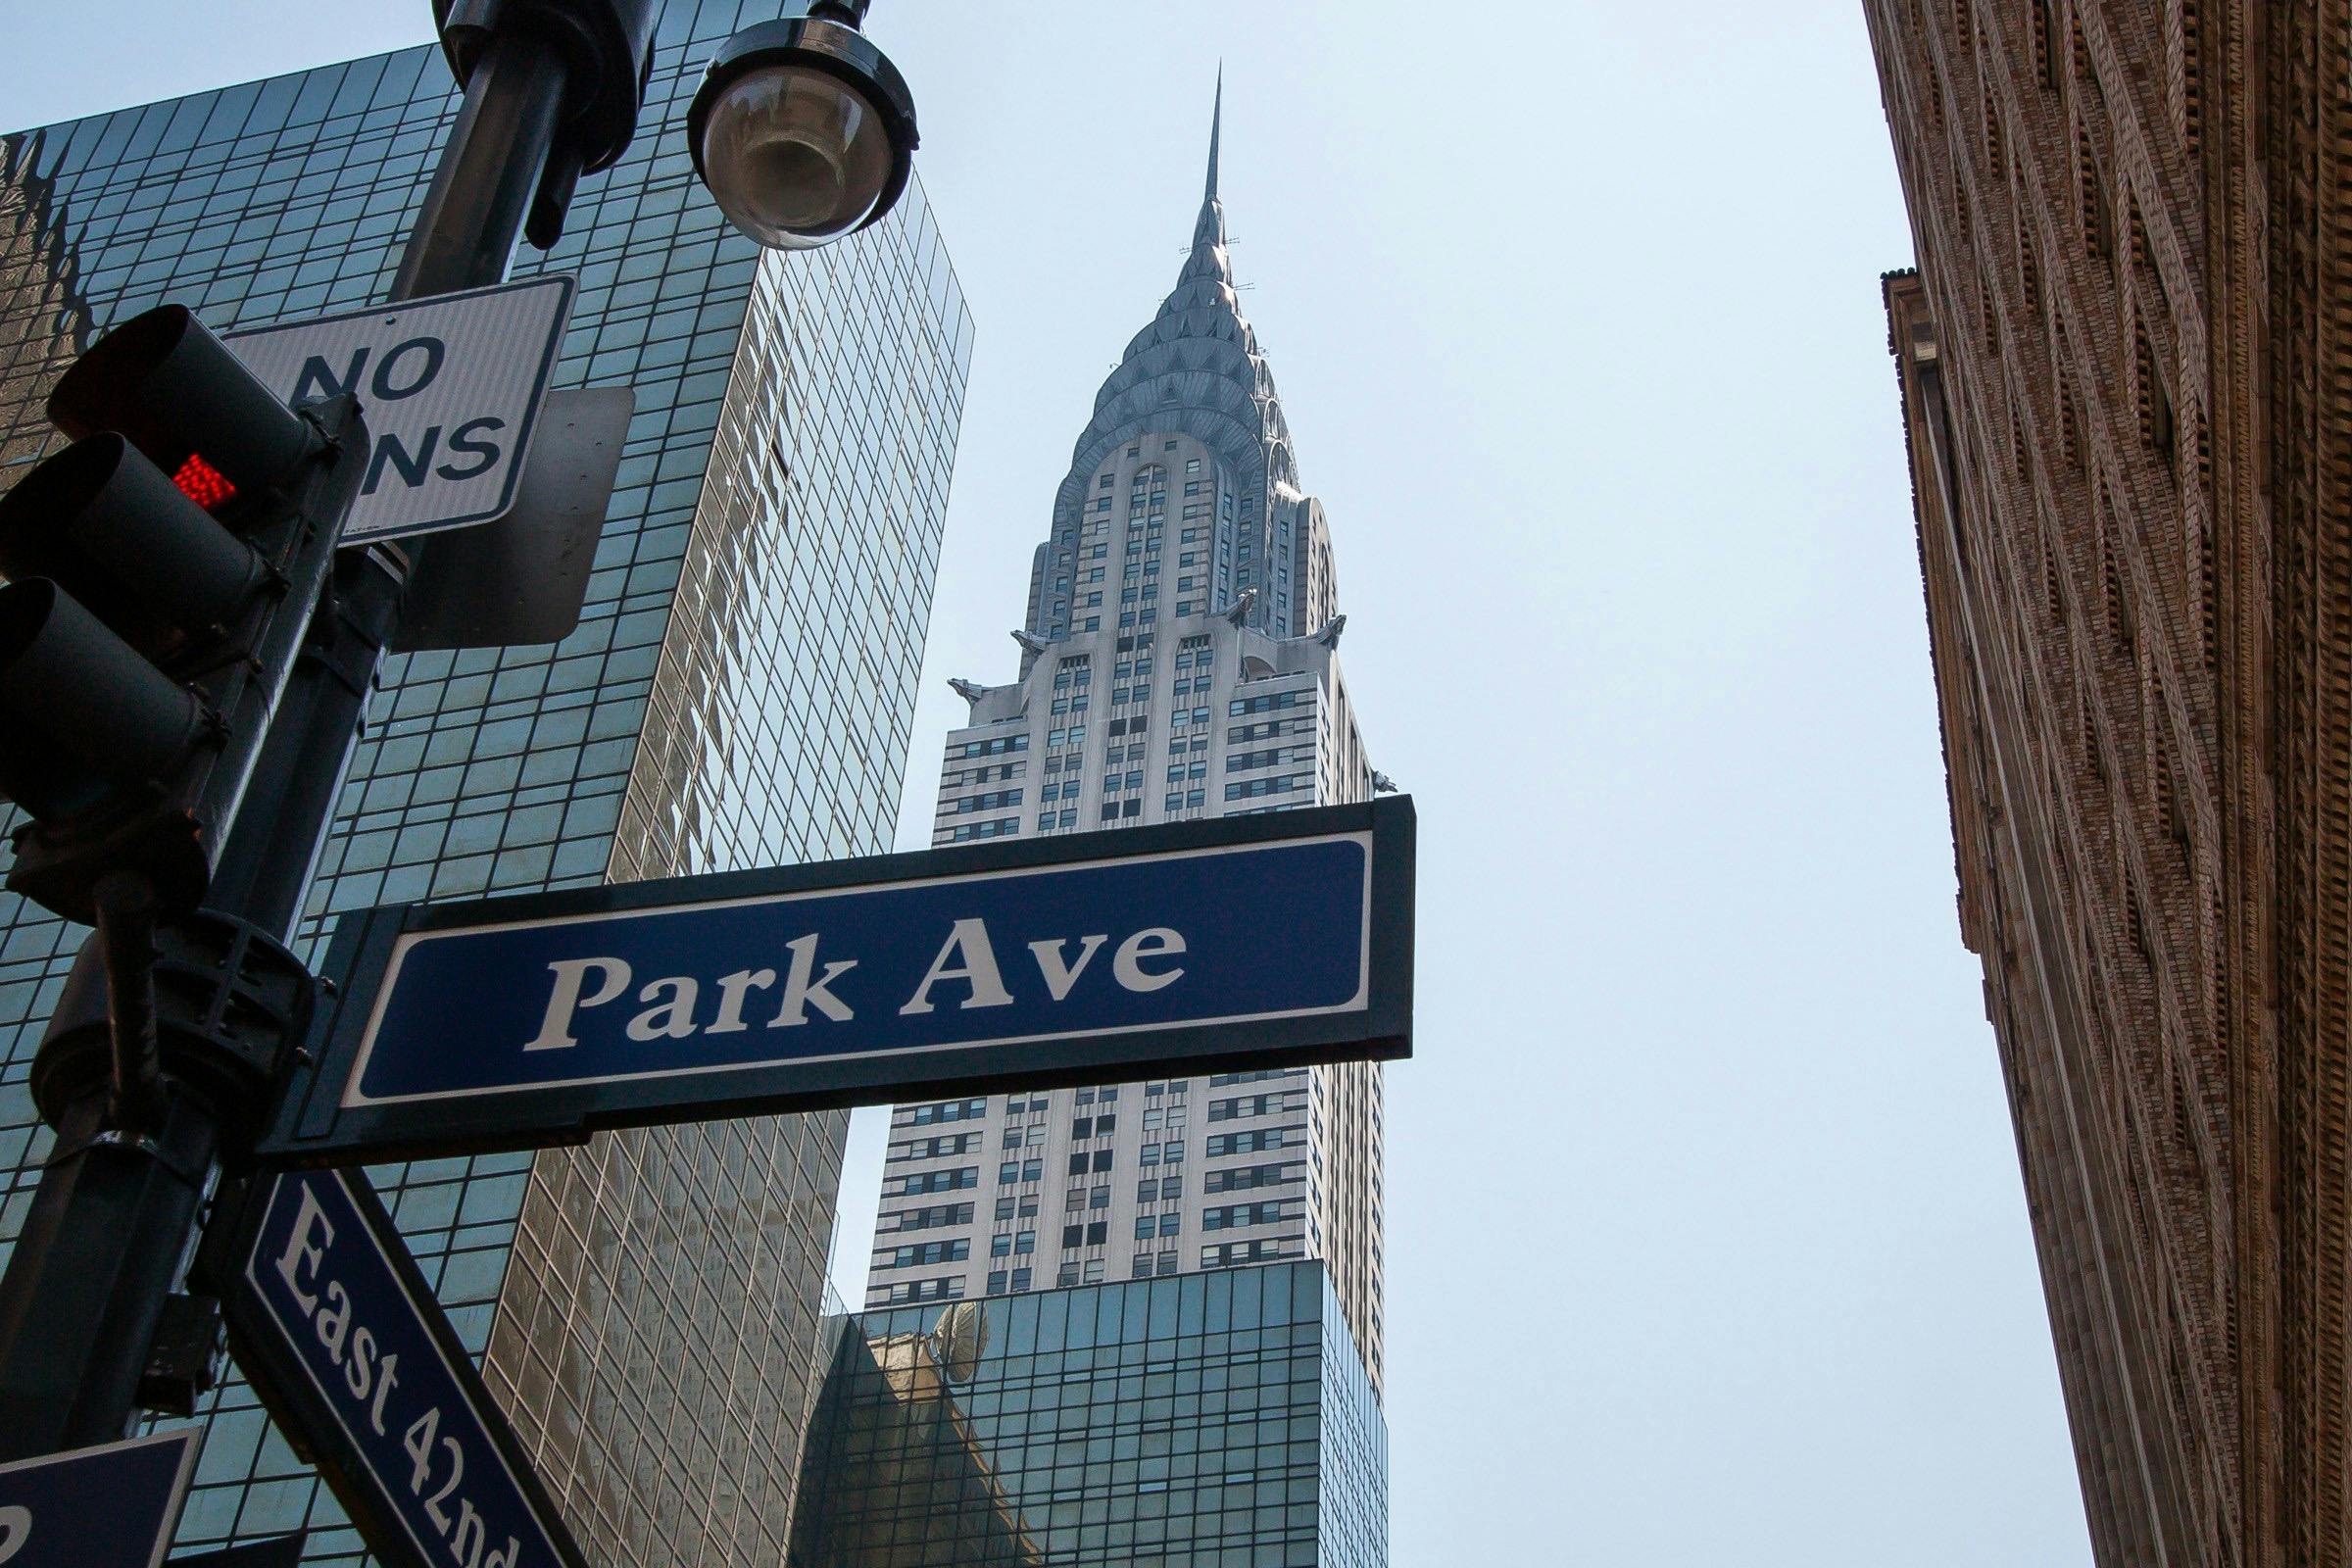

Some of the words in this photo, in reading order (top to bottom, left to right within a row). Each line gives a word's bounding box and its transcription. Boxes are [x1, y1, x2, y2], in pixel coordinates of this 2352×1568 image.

[288, 336, 446, 410] NO
[522, 932, 858, 1052] Park
[899, 917, 1187, 1015] Ave
[275, 1179, 399, 1437] East
